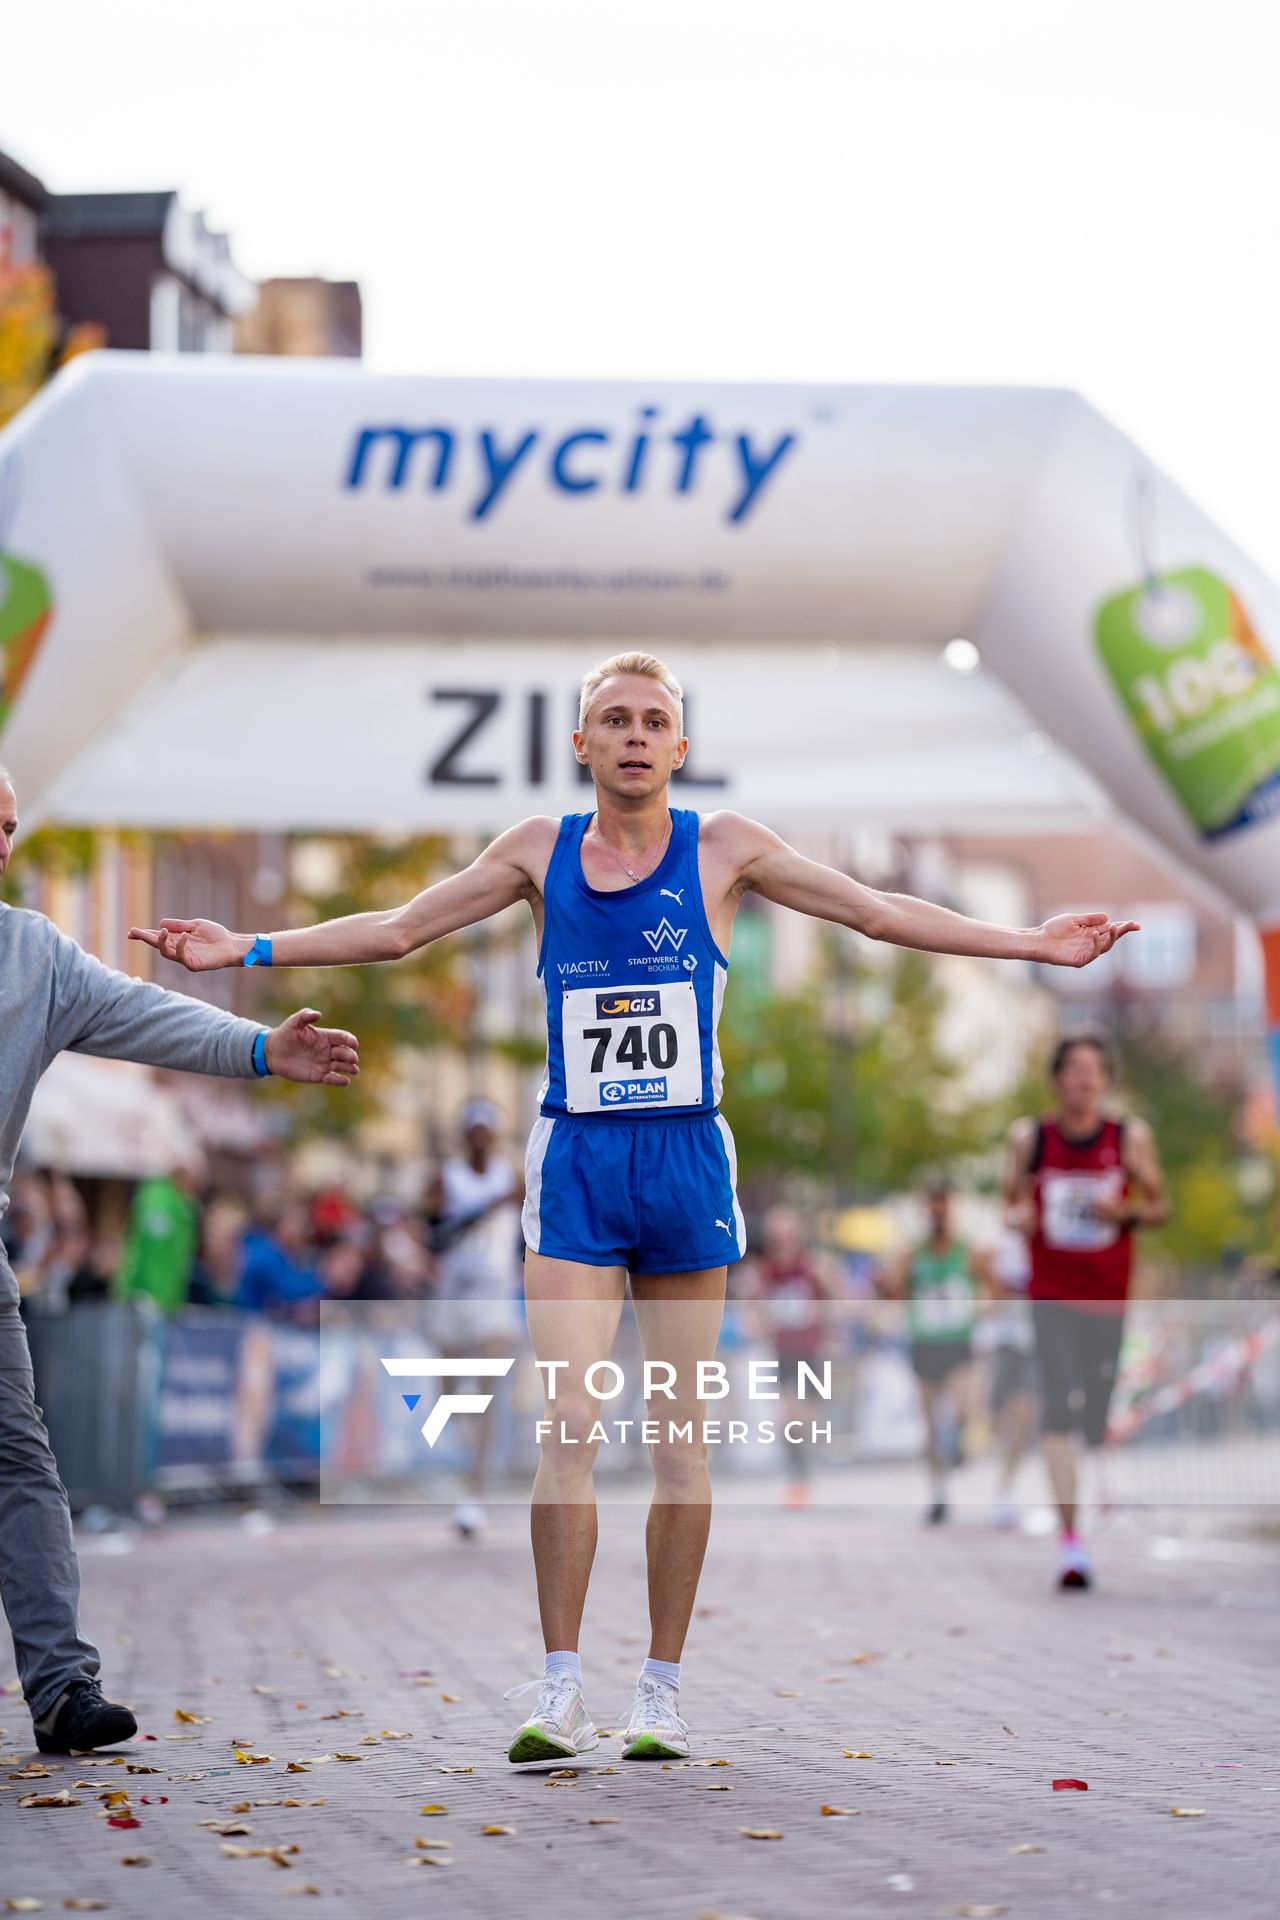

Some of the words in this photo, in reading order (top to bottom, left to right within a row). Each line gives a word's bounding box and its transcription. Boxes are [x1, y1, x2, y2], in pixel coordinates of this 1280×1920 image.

[343, 402, 798, 525] mycity
[557, 959, 610, 975] VIACTIV
[627, 955, 679, 966] STADTWERKE
[647, 964, 680, 973] BOCHUM
[629, 997, 655, 1013] GLS
[583, 1022, 679, 1074] 740
[627, 1081, 665, 1095] PLAN
